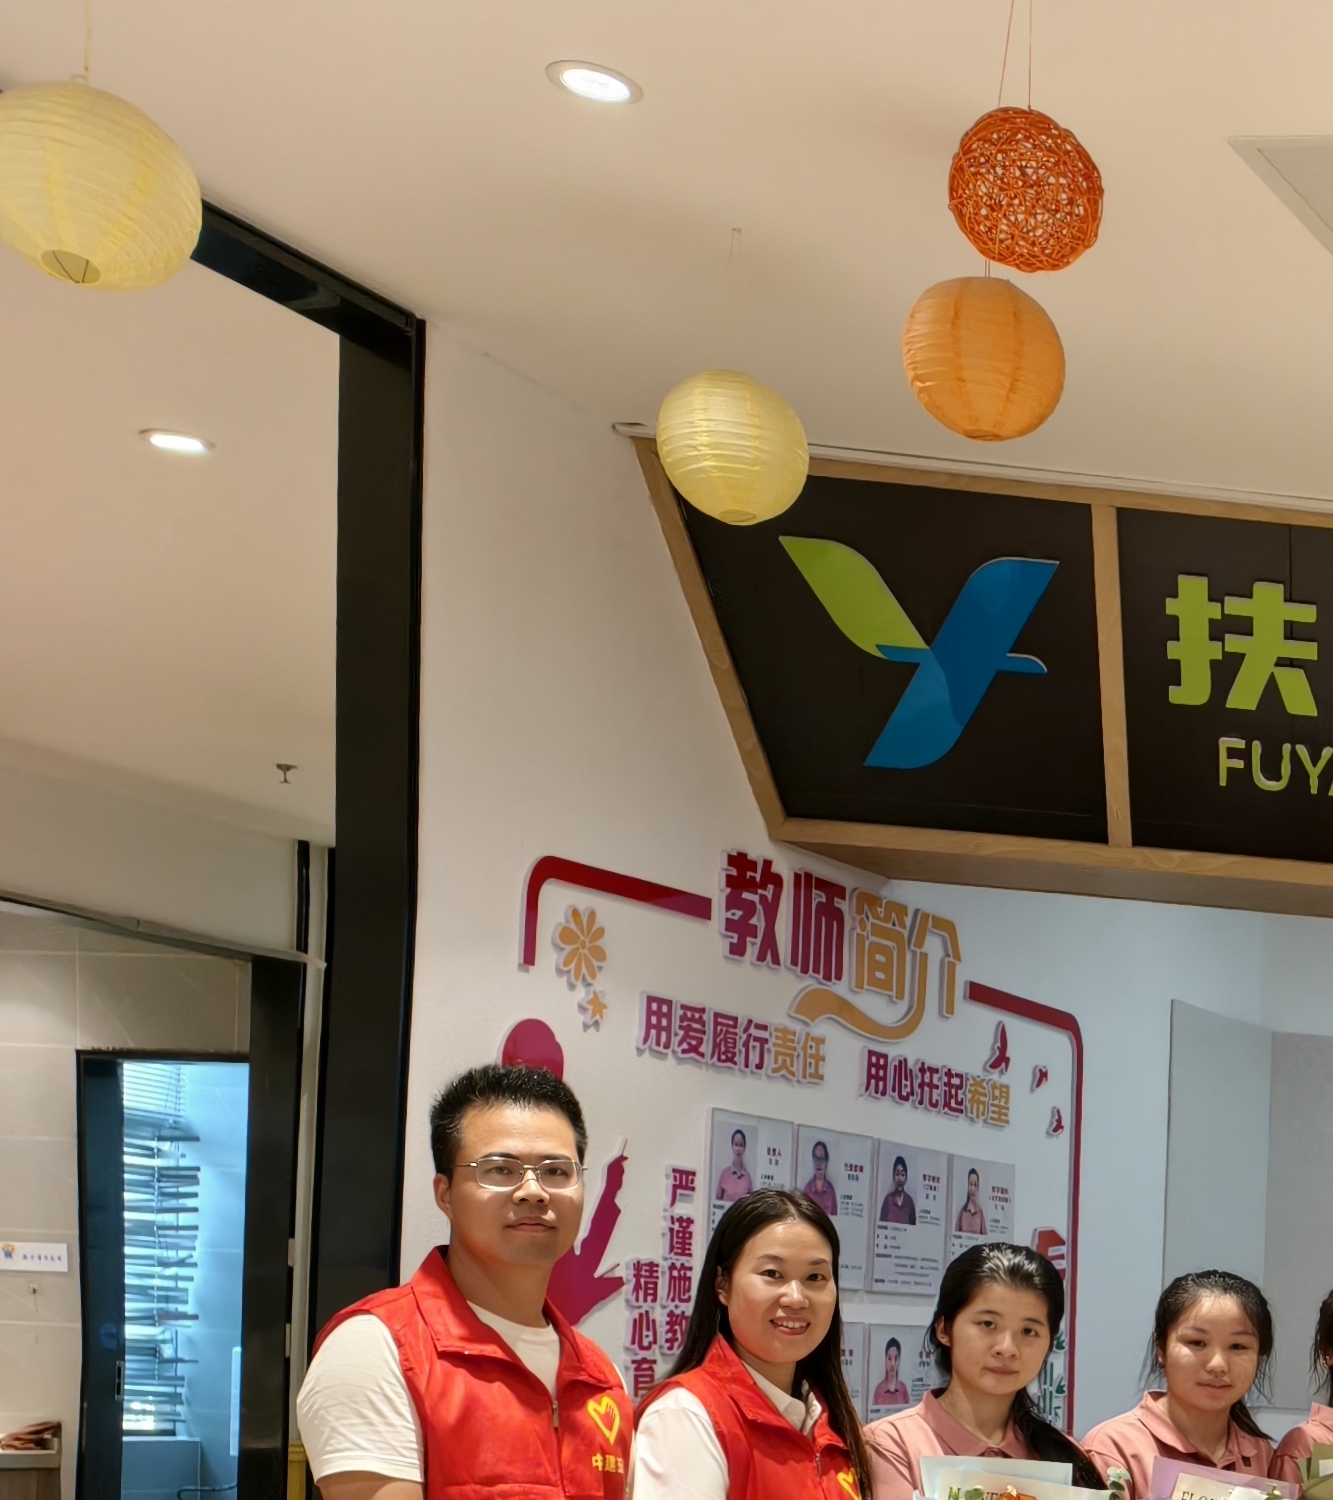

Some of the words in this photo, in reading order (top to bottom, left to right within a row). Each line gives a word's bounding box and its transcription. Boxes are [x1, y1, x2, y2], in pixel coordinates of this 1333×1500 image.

[718, 850, 962, 1040] 教师简介
[641, 992, 827, 1083] 用爱履行责任
[863, 1048, 1011, 1126] 用心托起希望
